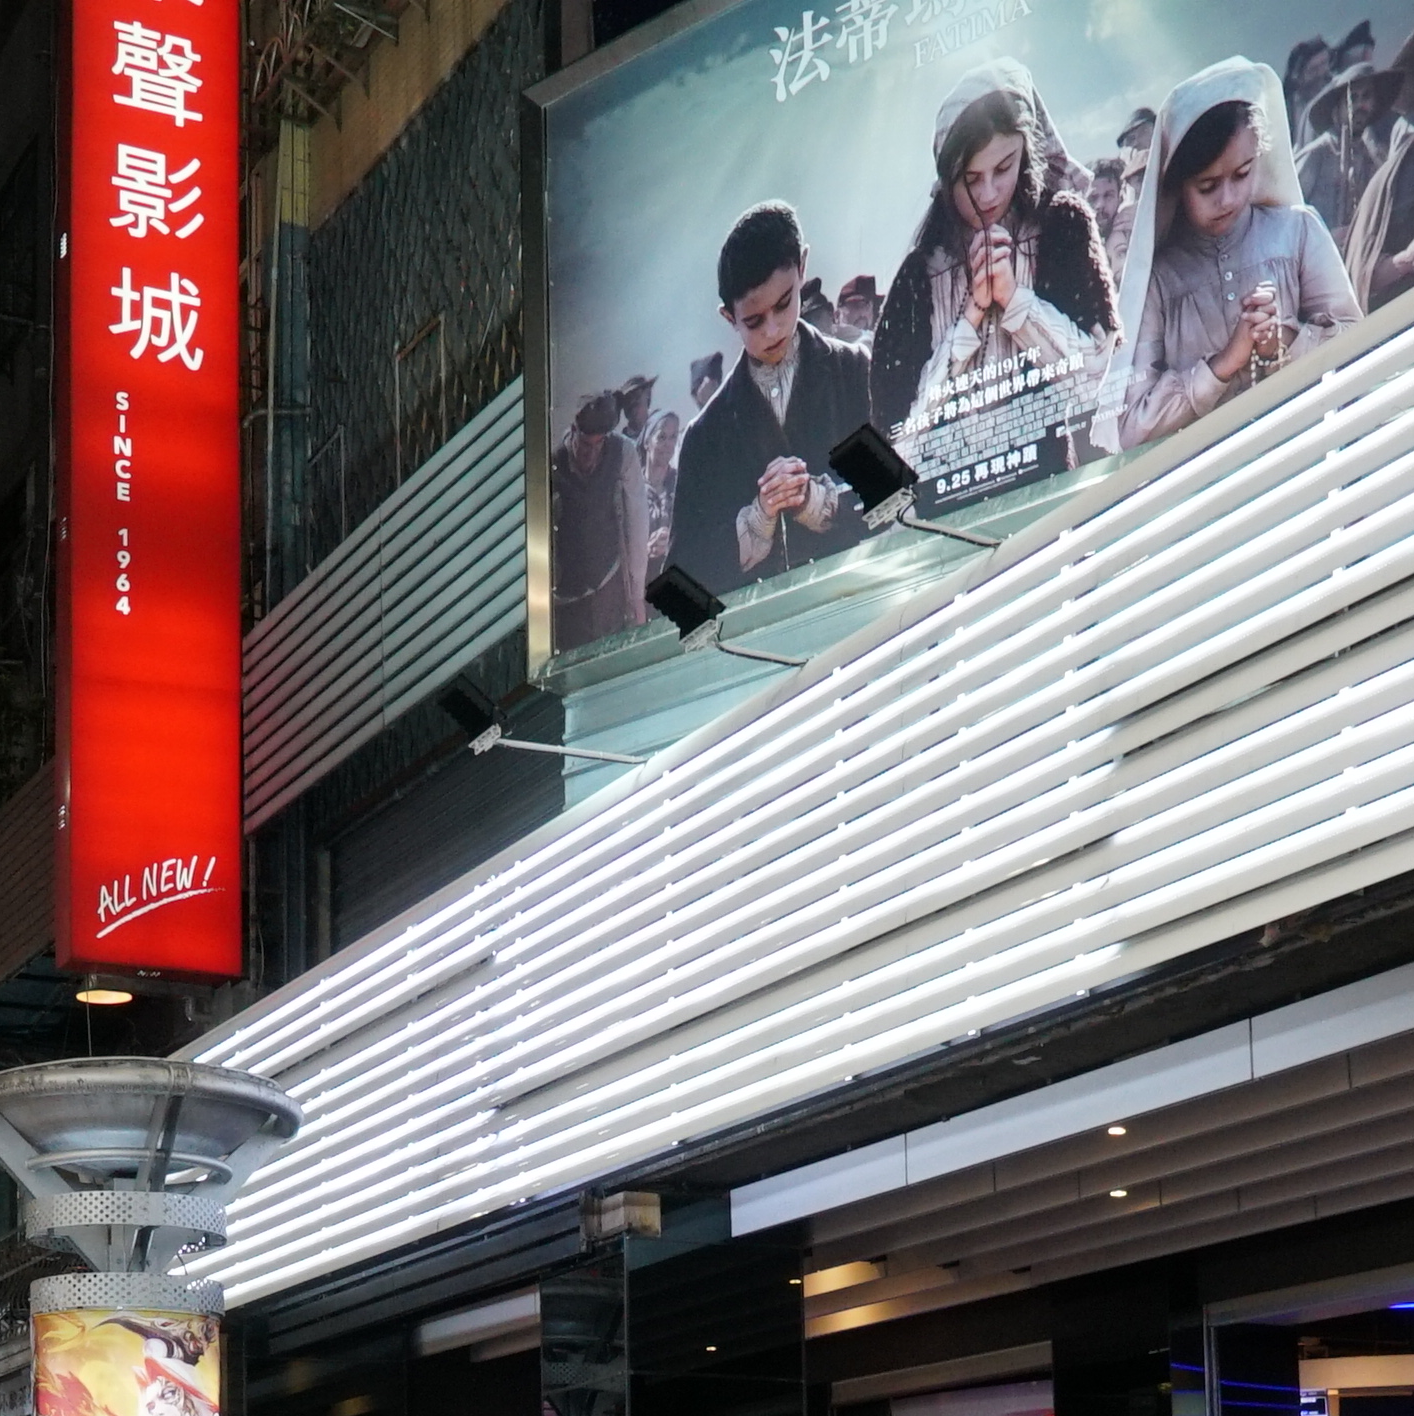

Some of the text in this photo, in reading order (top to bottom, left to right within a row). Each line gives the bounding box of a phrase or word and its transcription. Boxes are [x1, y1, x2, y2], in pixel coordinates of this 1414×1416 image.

[108, 0, 205, 371] 聲影城
[115, 391, 133, 617] SINCE 1964
[936, 473, 972, 494] 9.25
[97, 874, 137, 923] ALL
